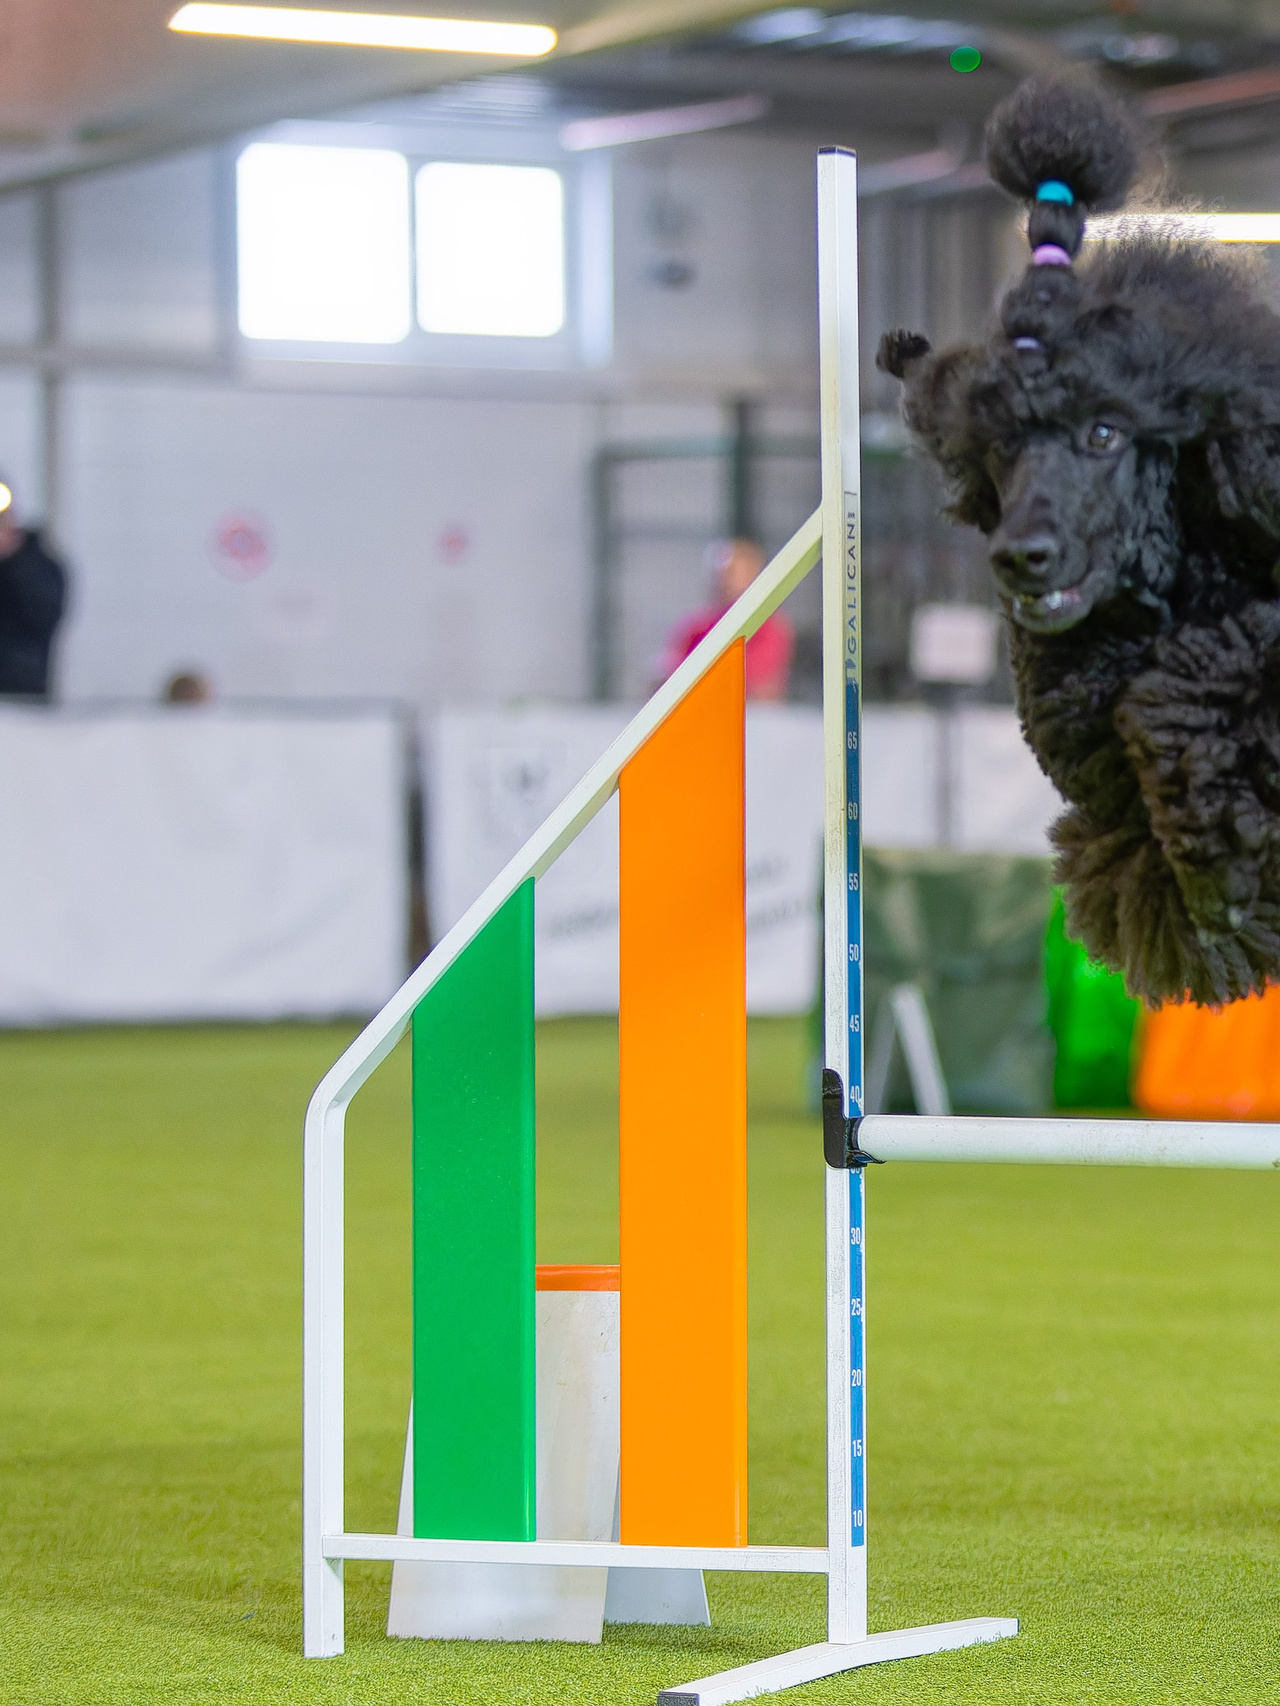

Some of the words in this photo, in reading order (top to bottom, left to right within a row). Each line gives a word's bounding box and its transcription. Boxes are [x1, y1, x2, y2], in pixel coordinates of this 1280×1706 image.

[847, 802, 858, 820] 60
[848, 873, 859, 891] 55
[849, 944, 860, 962] 50
[849, 1014, 860, 1033] 45
[850, 1085, 861, 1103] 40
[850, 1227, 861, 1245] 30
[851, 1298, 862, 1316] 25
[851, 1368, 862, 1387] 20
[852, 1439, 863, 1457] 15
[852, 1509, 863, 1527] 10
